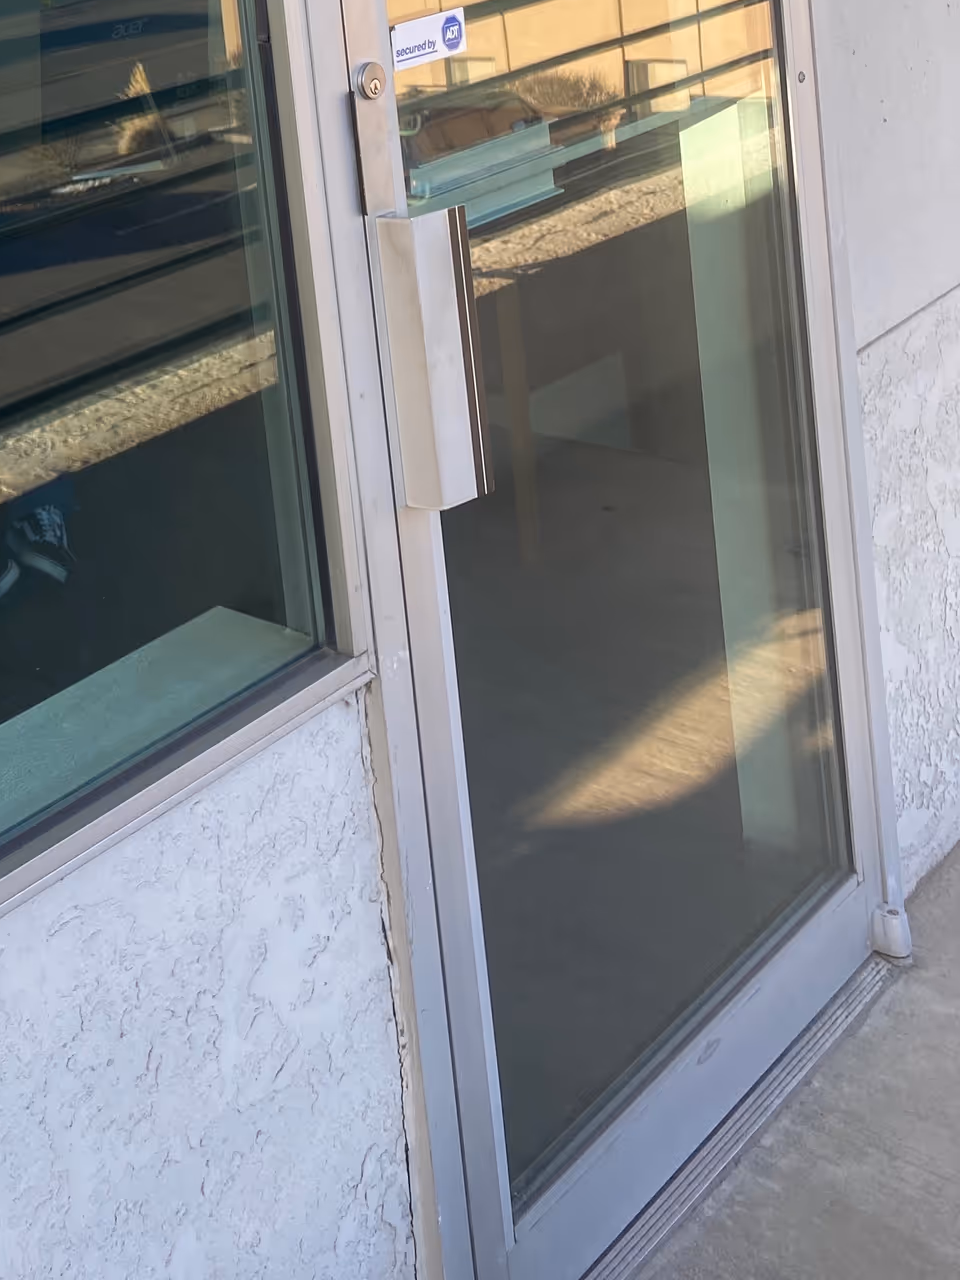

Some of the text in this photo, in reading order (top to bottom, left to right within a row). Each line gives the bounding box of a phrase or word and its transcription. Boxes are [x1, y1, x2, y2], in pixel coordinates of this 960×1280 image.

[445, 25, 460, 42] ADT
[395, 38, 437, 58] secured by
